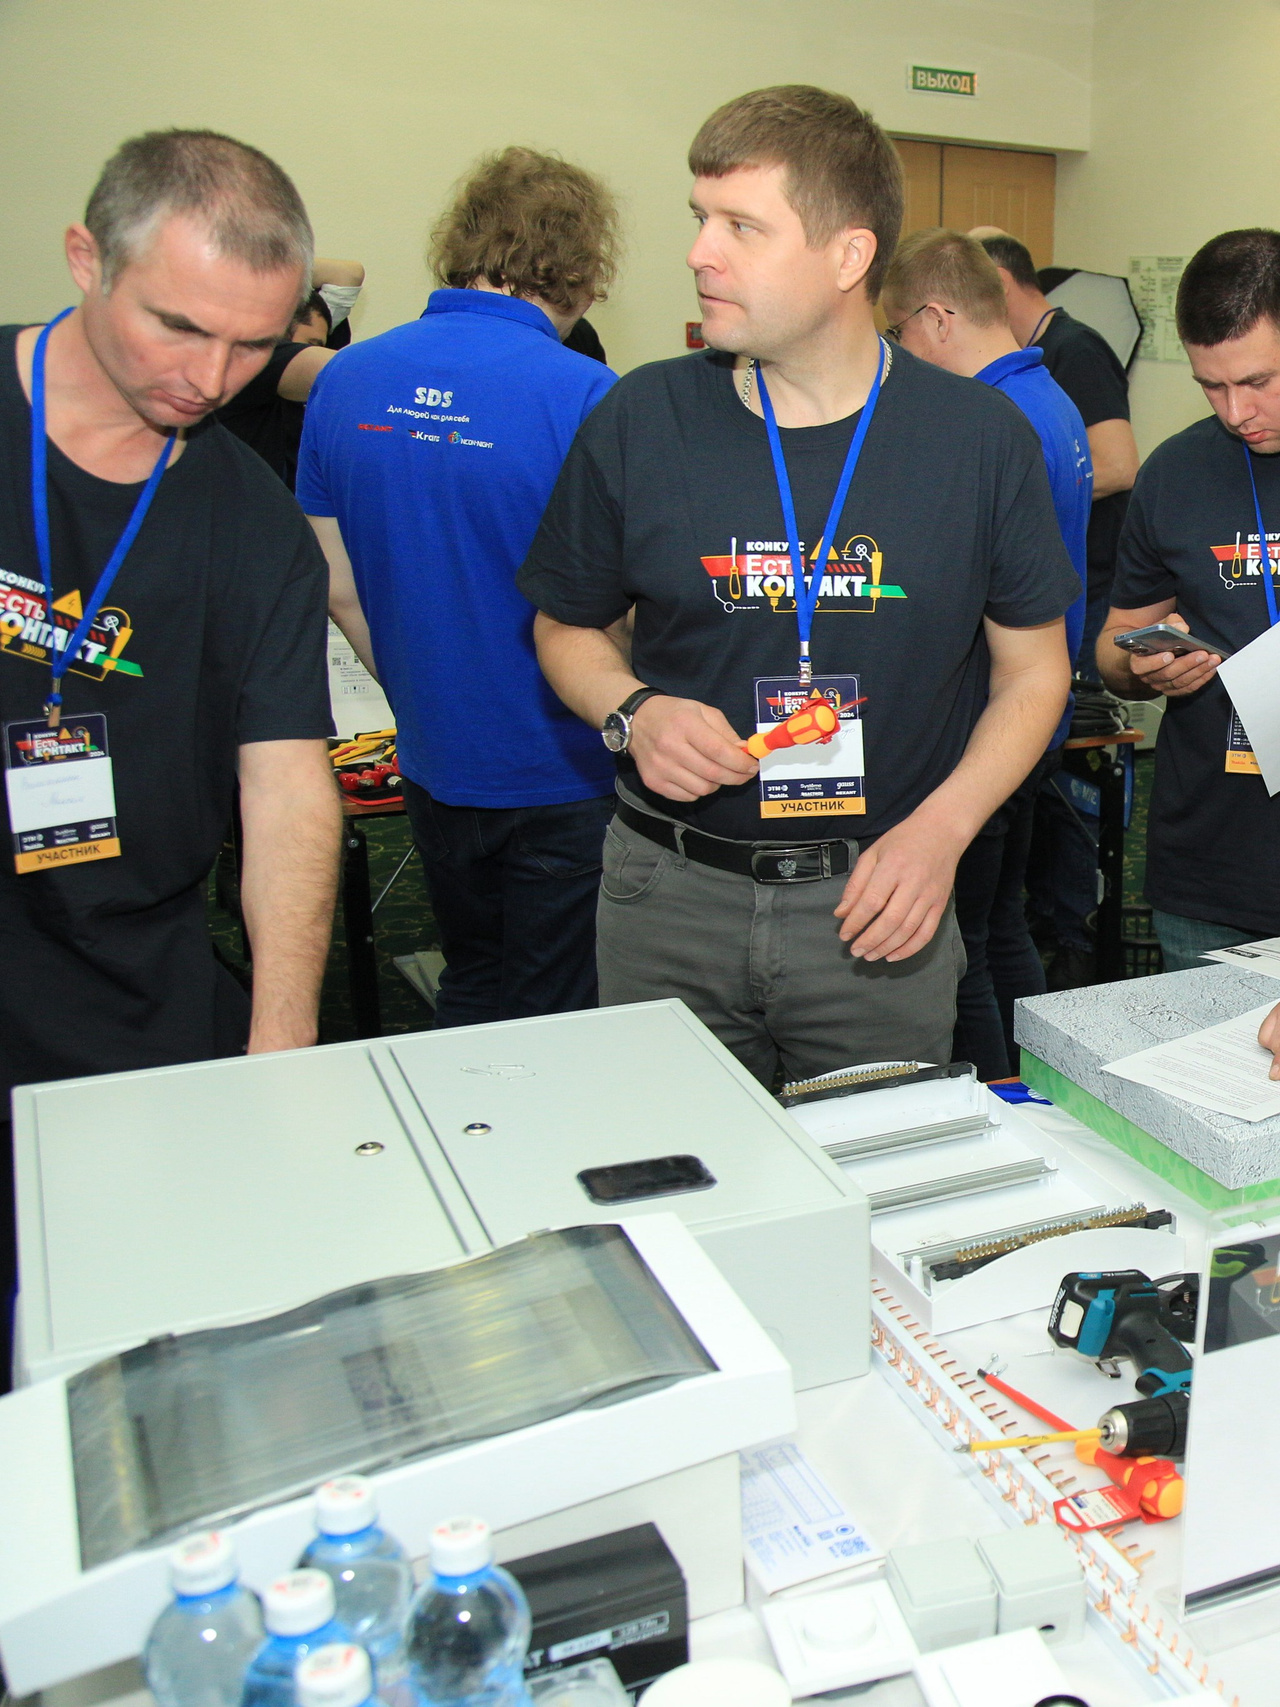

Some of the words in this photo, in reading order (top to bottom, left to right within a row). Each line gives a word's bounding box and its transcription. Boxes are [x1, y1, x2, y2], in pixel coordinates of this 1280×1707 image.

[917, 70, 971, 93] ВЫХОД
[414, 387, 453, 408] SDS
[387, 405, 402, 413] Для
[403, 408, 430, 420] людей
[440, 414, 453, 423] для
[453, 415, 470, 423] себя
[746, 541, 805, 552] КОНКУС
[747, 554, 805, 575] Ест
[0, 568, 53, 594] КОНКУР
[35, 743, 86, 758] КОНТАКТ
[781, 801, 845, 813] УЧАСТНИК
[37, 844, 101, 864] УЧАСТНИК
